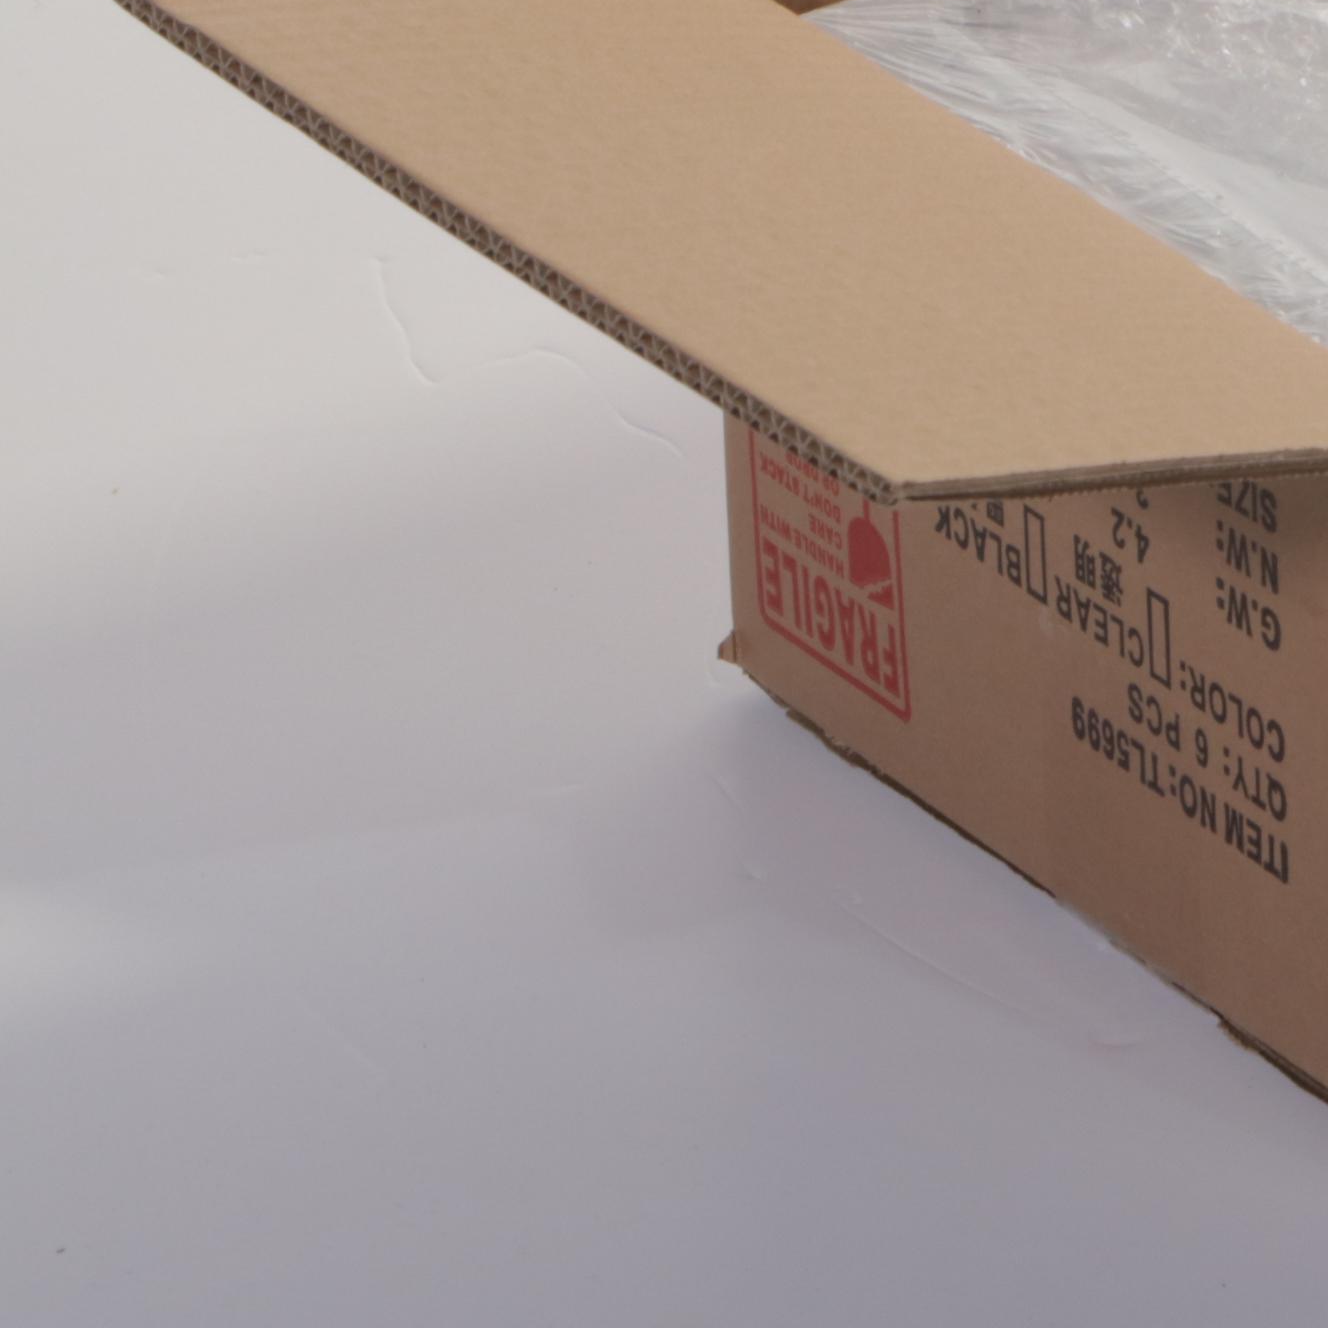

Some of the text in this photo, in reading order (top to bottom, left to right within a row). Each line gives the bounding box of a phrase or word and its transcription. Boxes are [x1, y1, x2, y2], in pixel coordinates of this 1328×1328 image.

[759, 451, 841, 522] DON'T STACK
[760, 503, 845, 579] HANDLE WITH
[808, 514, 843, 550] CARE
[1074, 534, 1123, 607] 透明
[1216, 519, 1280, 595] N.W:
[763, 536, 901, 699] FRAGILE
[1111, 507, 1282, 652] G.W: 4.2
[935, 505, 1284, 763] COLOR: CLEAR BLACK
[1128, 683, 1287, 822] QTY: 6 PCS
[1224, 802, 1288, 884] ITEM
